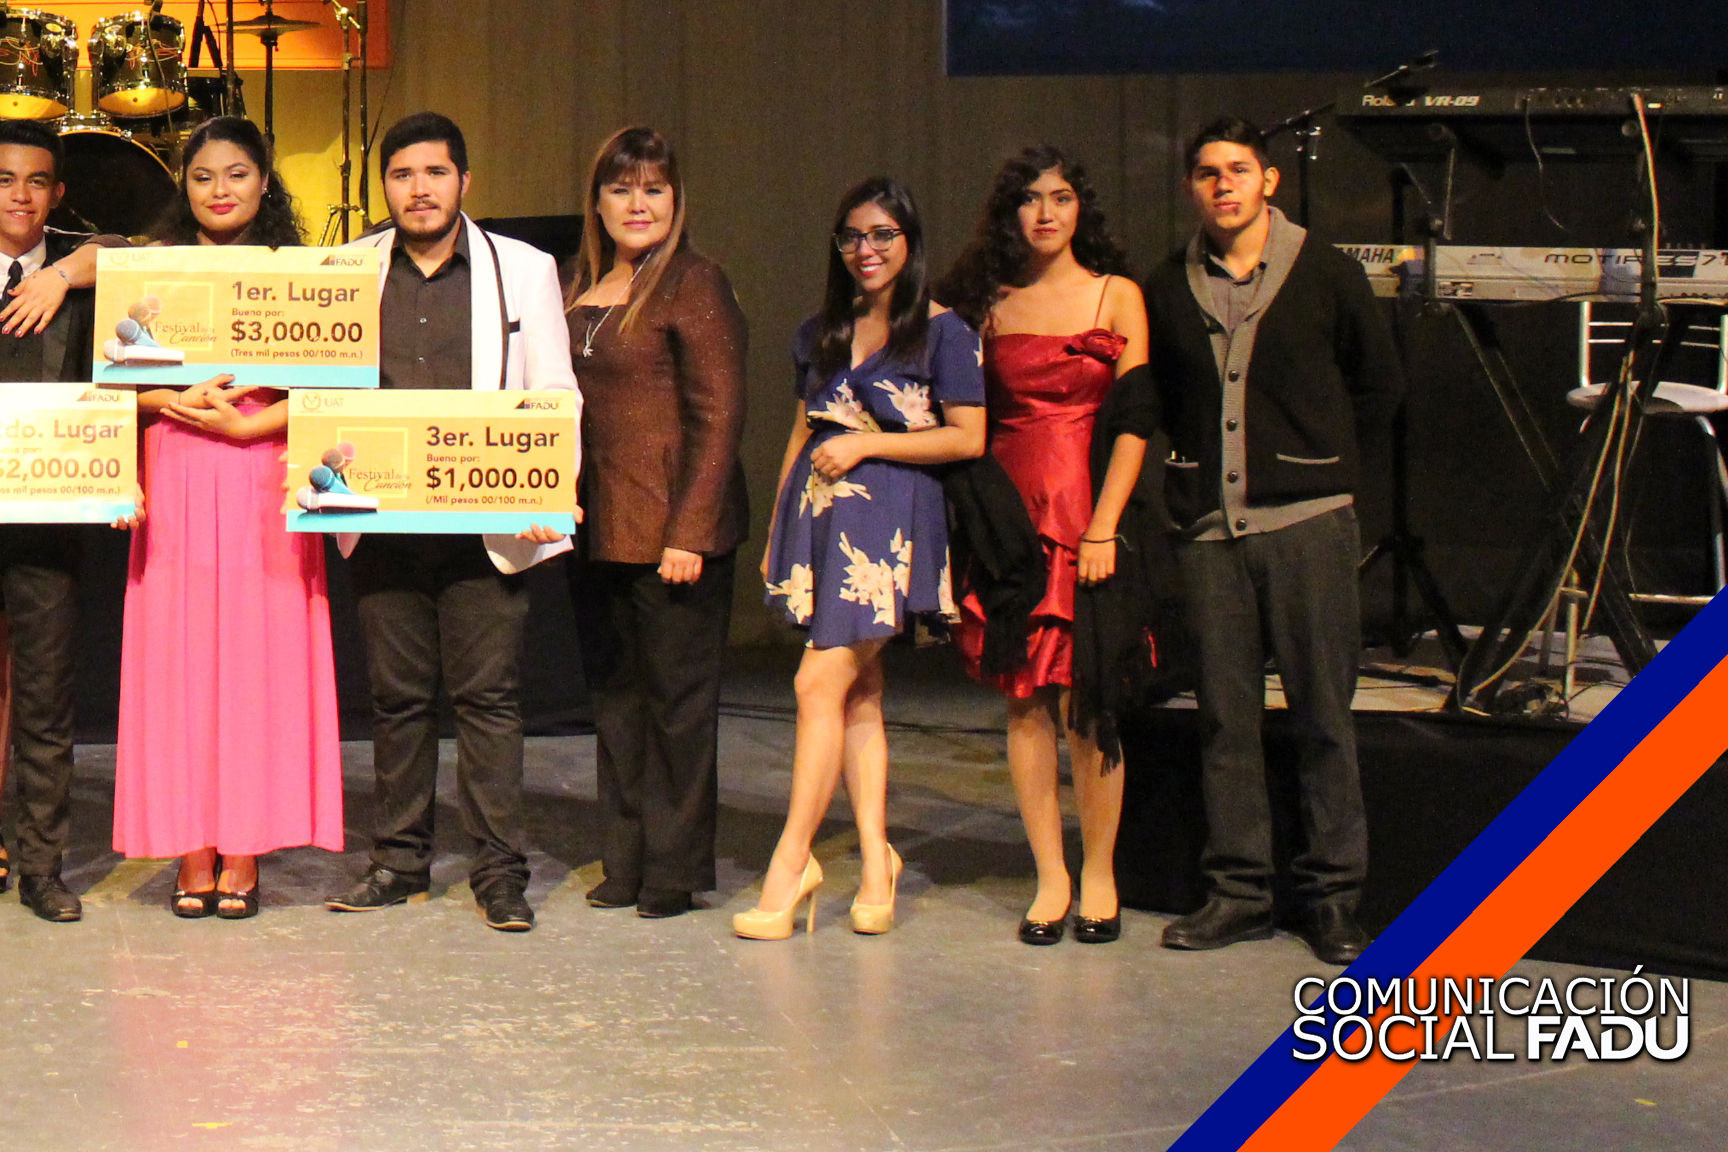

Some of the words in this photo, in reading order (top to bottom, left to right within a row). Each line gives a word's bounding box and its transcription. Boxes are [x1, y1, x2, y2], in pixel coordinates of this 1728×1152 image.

[1425, 95, 1481, 106] VR-09
[336, 258, 363, 267] FADU
[232, 280, 277, 301] 1er.
[288, 281, 360, 308] Lugar
[232, 308, 262, 317] Bueno
[264, 309, 285, 318] por:
[154, 321, 200, 334] Festival
[231, 319, 363, 345] $3,000.00
[230, 348, 253, 358] (Tres
[256, 349, 270, 358] mil
[272, 351, 300, 359] pesos
[302, 349, 337, 358] 00/100
[92, 394, 120, 403] FADU
[531, 402, 560, 410] FADU
[54, 419, 123, 444] Lugar
[426, 425, 474, 447] 3er.
[485, 426, 560, 453] Lugar
[426, 454, 457, 463] Bueno
[460, 456, 481, 465] por:
[348, 468, 394, 480] Festival
[426, 465, 560, 492] $1,000.00
[13, 485, 27, 495] mil
[30, 487, 58, 496] pesos
[60, 485, 94, 494] 00/100
[451, 497, 479, 506] pesos
[481, 495, 516, 504] 00/100
